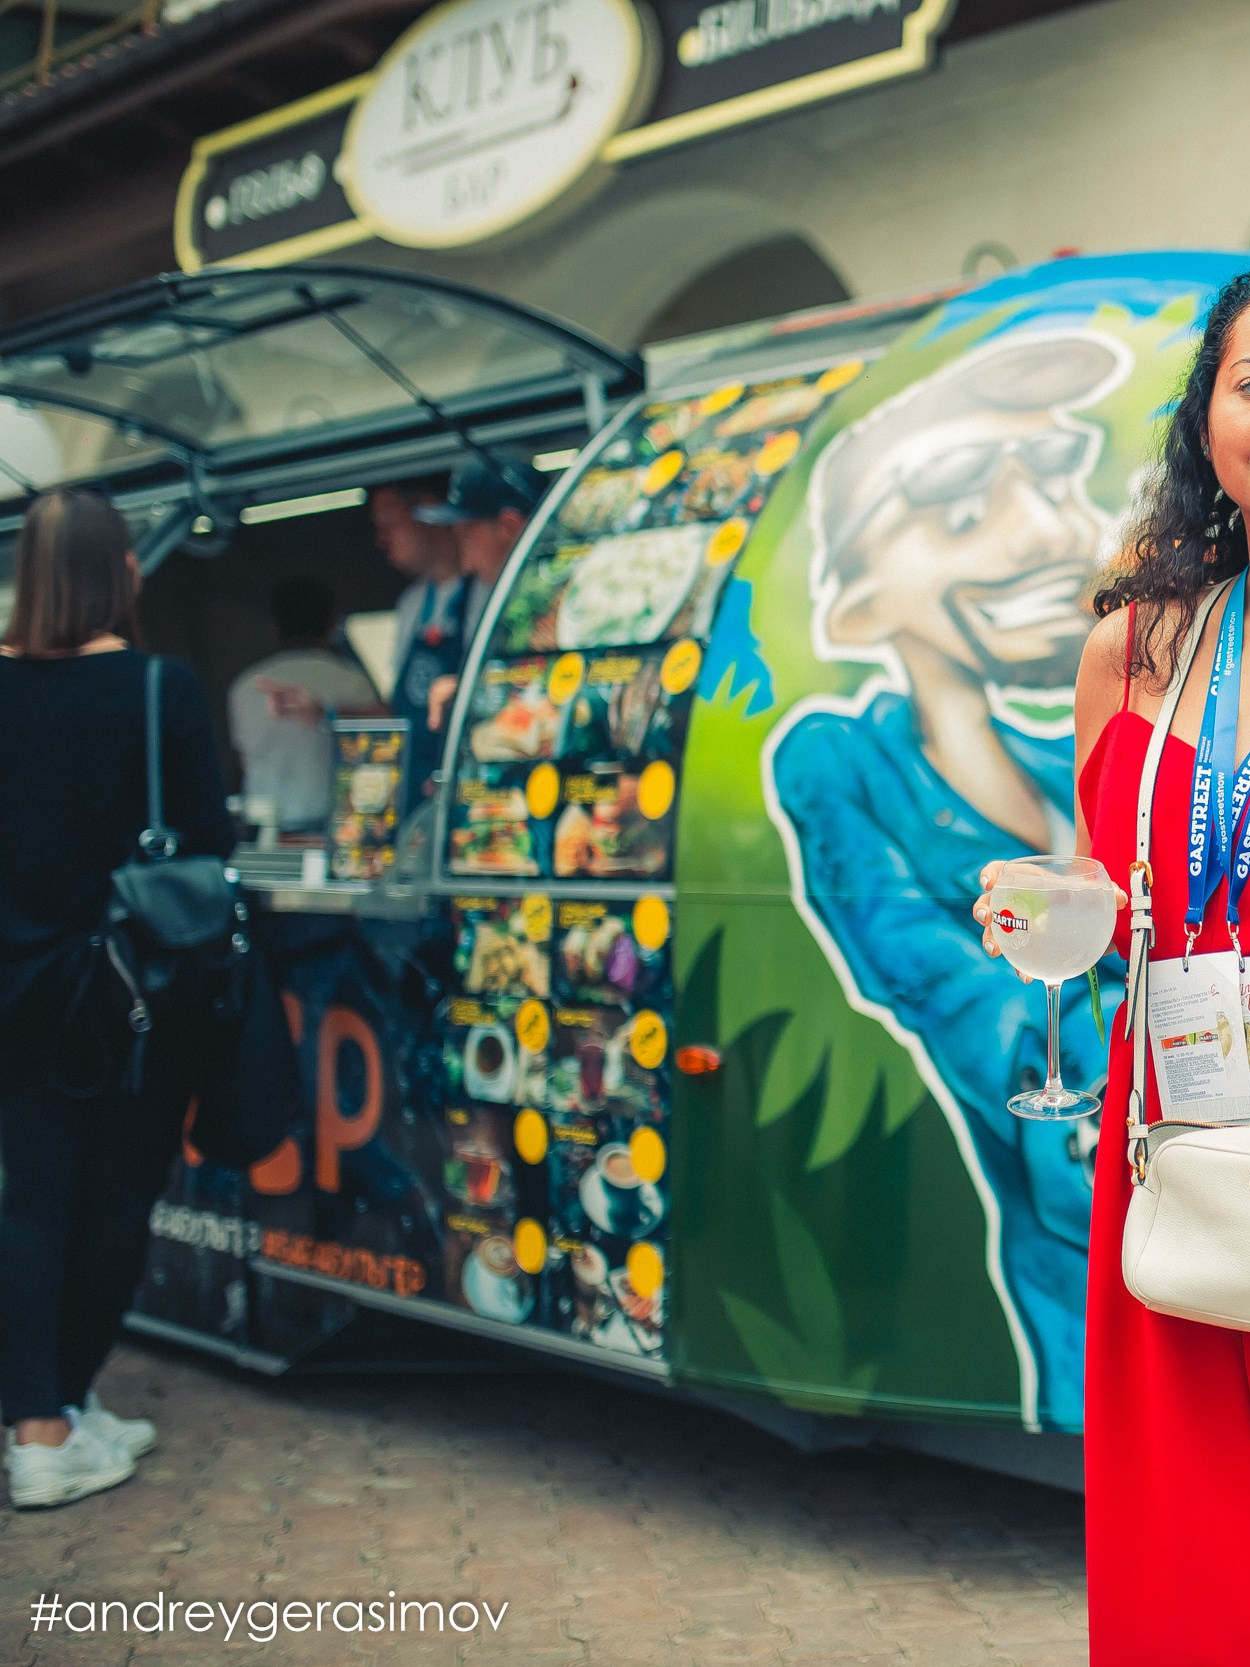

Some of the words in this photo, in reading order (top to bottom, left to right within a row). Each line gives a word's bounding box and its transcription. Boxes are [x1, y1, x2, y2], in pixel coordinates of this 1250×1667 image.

[402, 0, 569, 132] КЛУБ
[1224, 611, 1236, 676] #gastreetshow
[1189, 765, 1212, 877] GASTREET
[1216, 772, 1227, 853] #gastreetshow
[993, 911, 1027, 931] MARTINI
